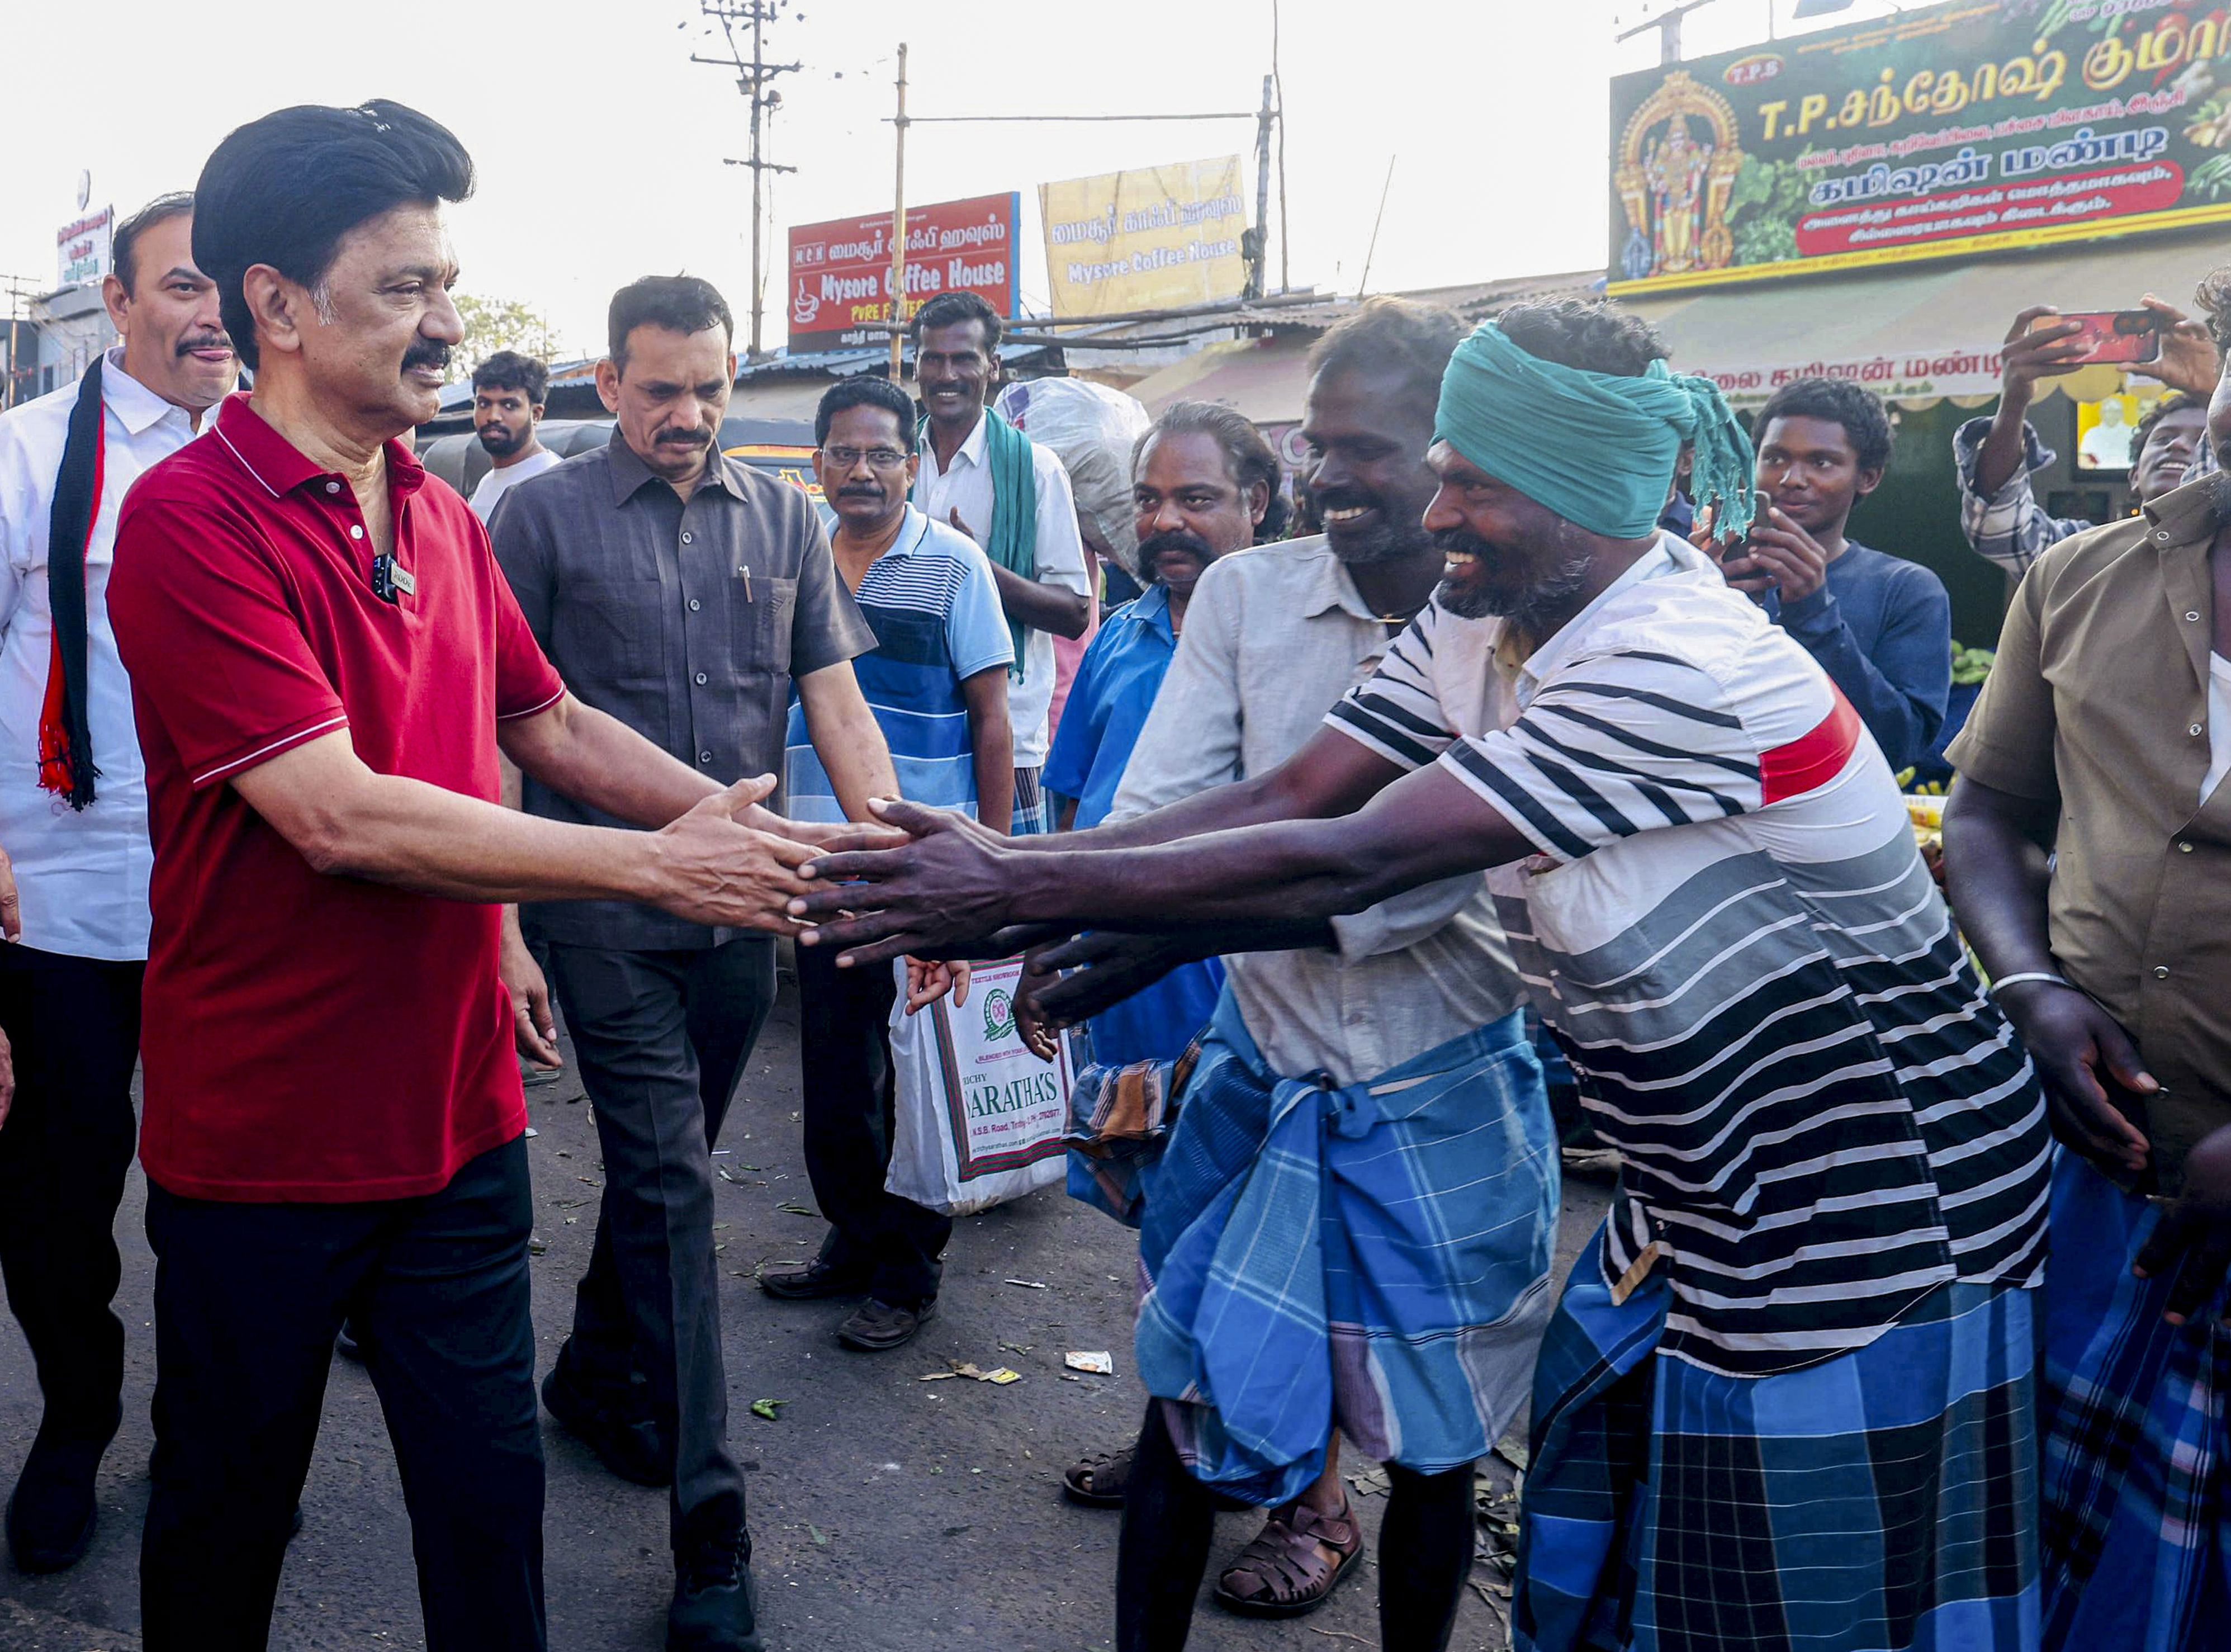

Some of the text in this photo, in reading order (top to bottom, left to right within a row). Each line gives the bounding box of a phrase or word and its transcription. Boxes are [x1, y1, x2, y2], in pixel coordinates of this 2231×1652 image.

[1809, 127, 2168, 207] கமிஷன் மண்டி
[829, 229, 884, 262] மைசூர்
[1068, 238, 1237, 284] Mysore Coffee House
[821, 257, 1005, 306] Mysore Cffee House
[883, 299, 925, 321] FTER
[963, 1073, 987, 1085] RICHY
